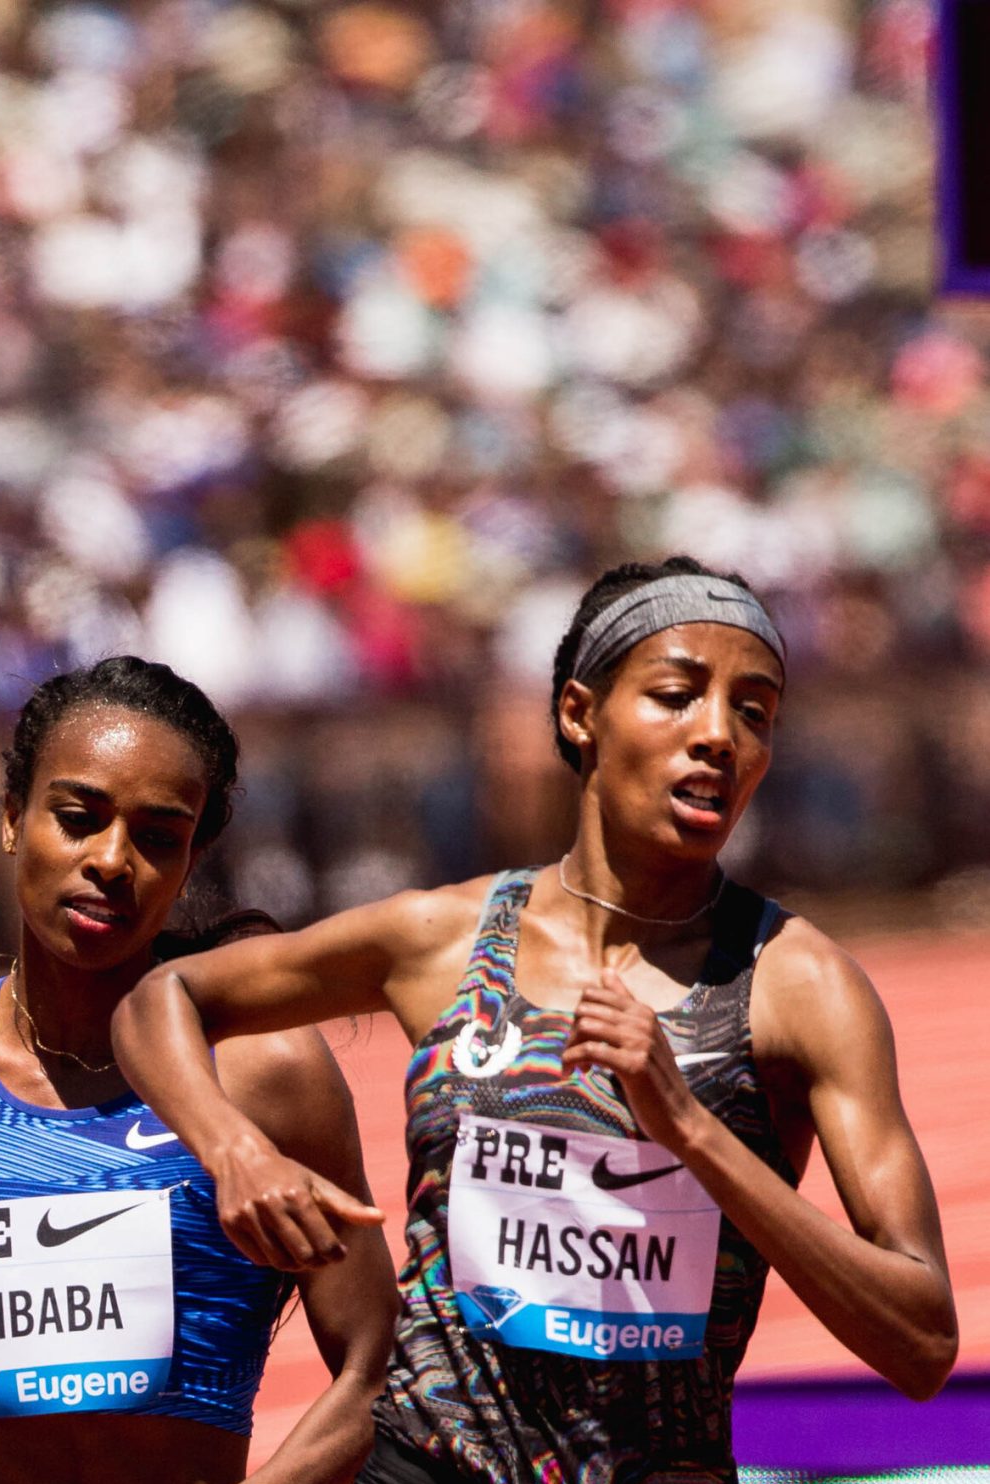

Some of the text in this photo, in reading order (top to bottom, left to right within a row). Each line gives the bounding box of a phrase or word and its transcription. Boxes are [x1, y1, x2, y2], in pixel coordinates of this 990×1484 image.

[470, 1126, 568, 1190] PRE
[497, 1217, 676, 1282] HASSAN
[545, 1309, 685, 1355] Eugene
[15, 1370, 150, 1405] Eugene
